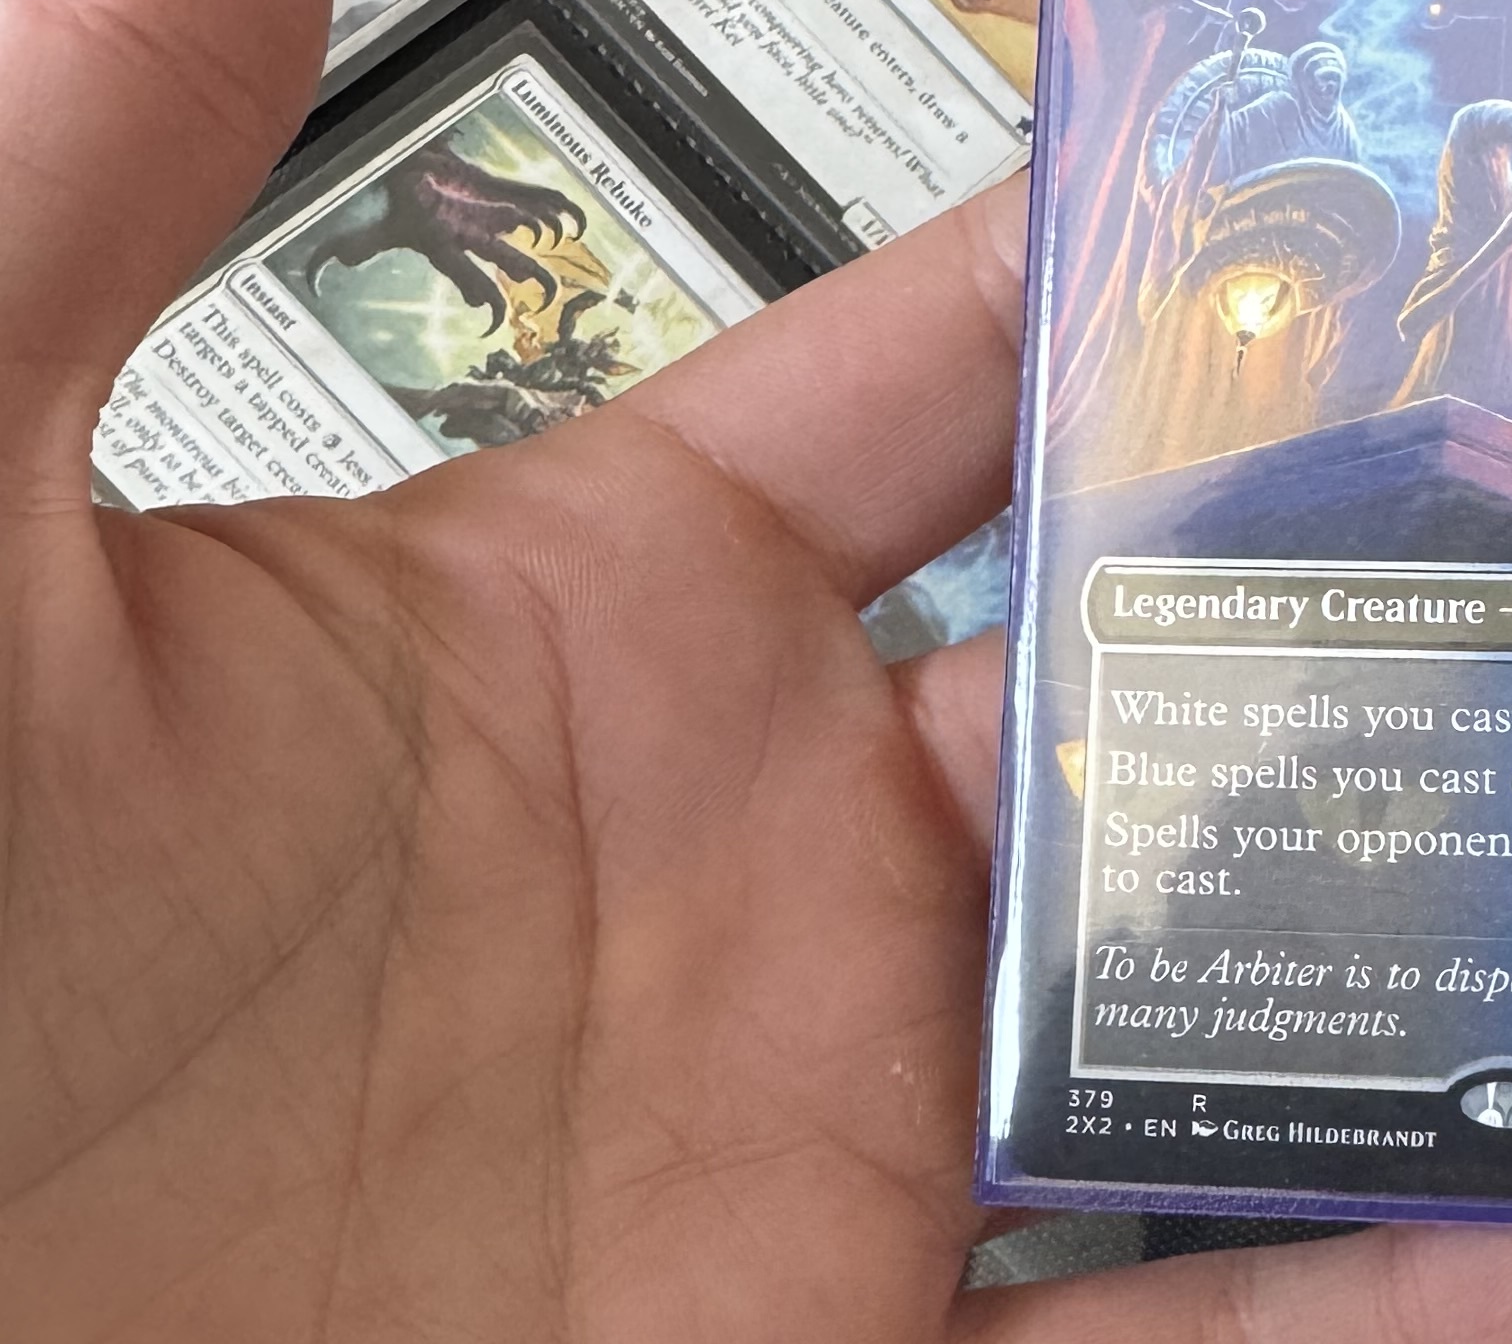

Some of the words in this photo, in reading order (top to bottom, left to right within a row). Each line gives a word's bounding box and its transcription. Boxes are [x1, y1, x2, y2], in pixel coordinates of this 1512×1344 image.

[506, 78, 599, 168] Luminous
[586, 159, 660, 230] Rebuke
[1114, 585, 1309, 628] Legendary
[1321, 589, 1485, 623] Creature
[1109, 689, 1229, 732] White
[1241, 690, 1349, 743] spells
[1361, 702, 1436, 742] you
[1106, 752, 1197, 792] Blue
[1209, 753, 1319, 801] spells
[1331, 764, 1404, 803] you
[1419, 763, 1498, 800] cast
[1102, 813, 1219, 861] Spells
[1231, 824, 1323, 863] your
[1101, 863, 1140, 896] to
[1154, 862, 1242, 900] cast.
[1093, 945, 1136, 987] To
[1148, 948, 1189, 989] be
[1197, 950, 1333, 994] Arbiter
[1345, 955, 1373, 995] is
[1384, 960, 1422, 996] to
[1091, 1000, 1198, 1041] many
[1205, 997, 1409, 1046] judgments.
[1068, 1089, 1114, 1109] 379
[1192, 1094, 1207, 1112] R
[1065, 1115, 1113, 1135] 2X2
[1144, 1118, 1177, 1137] EN
